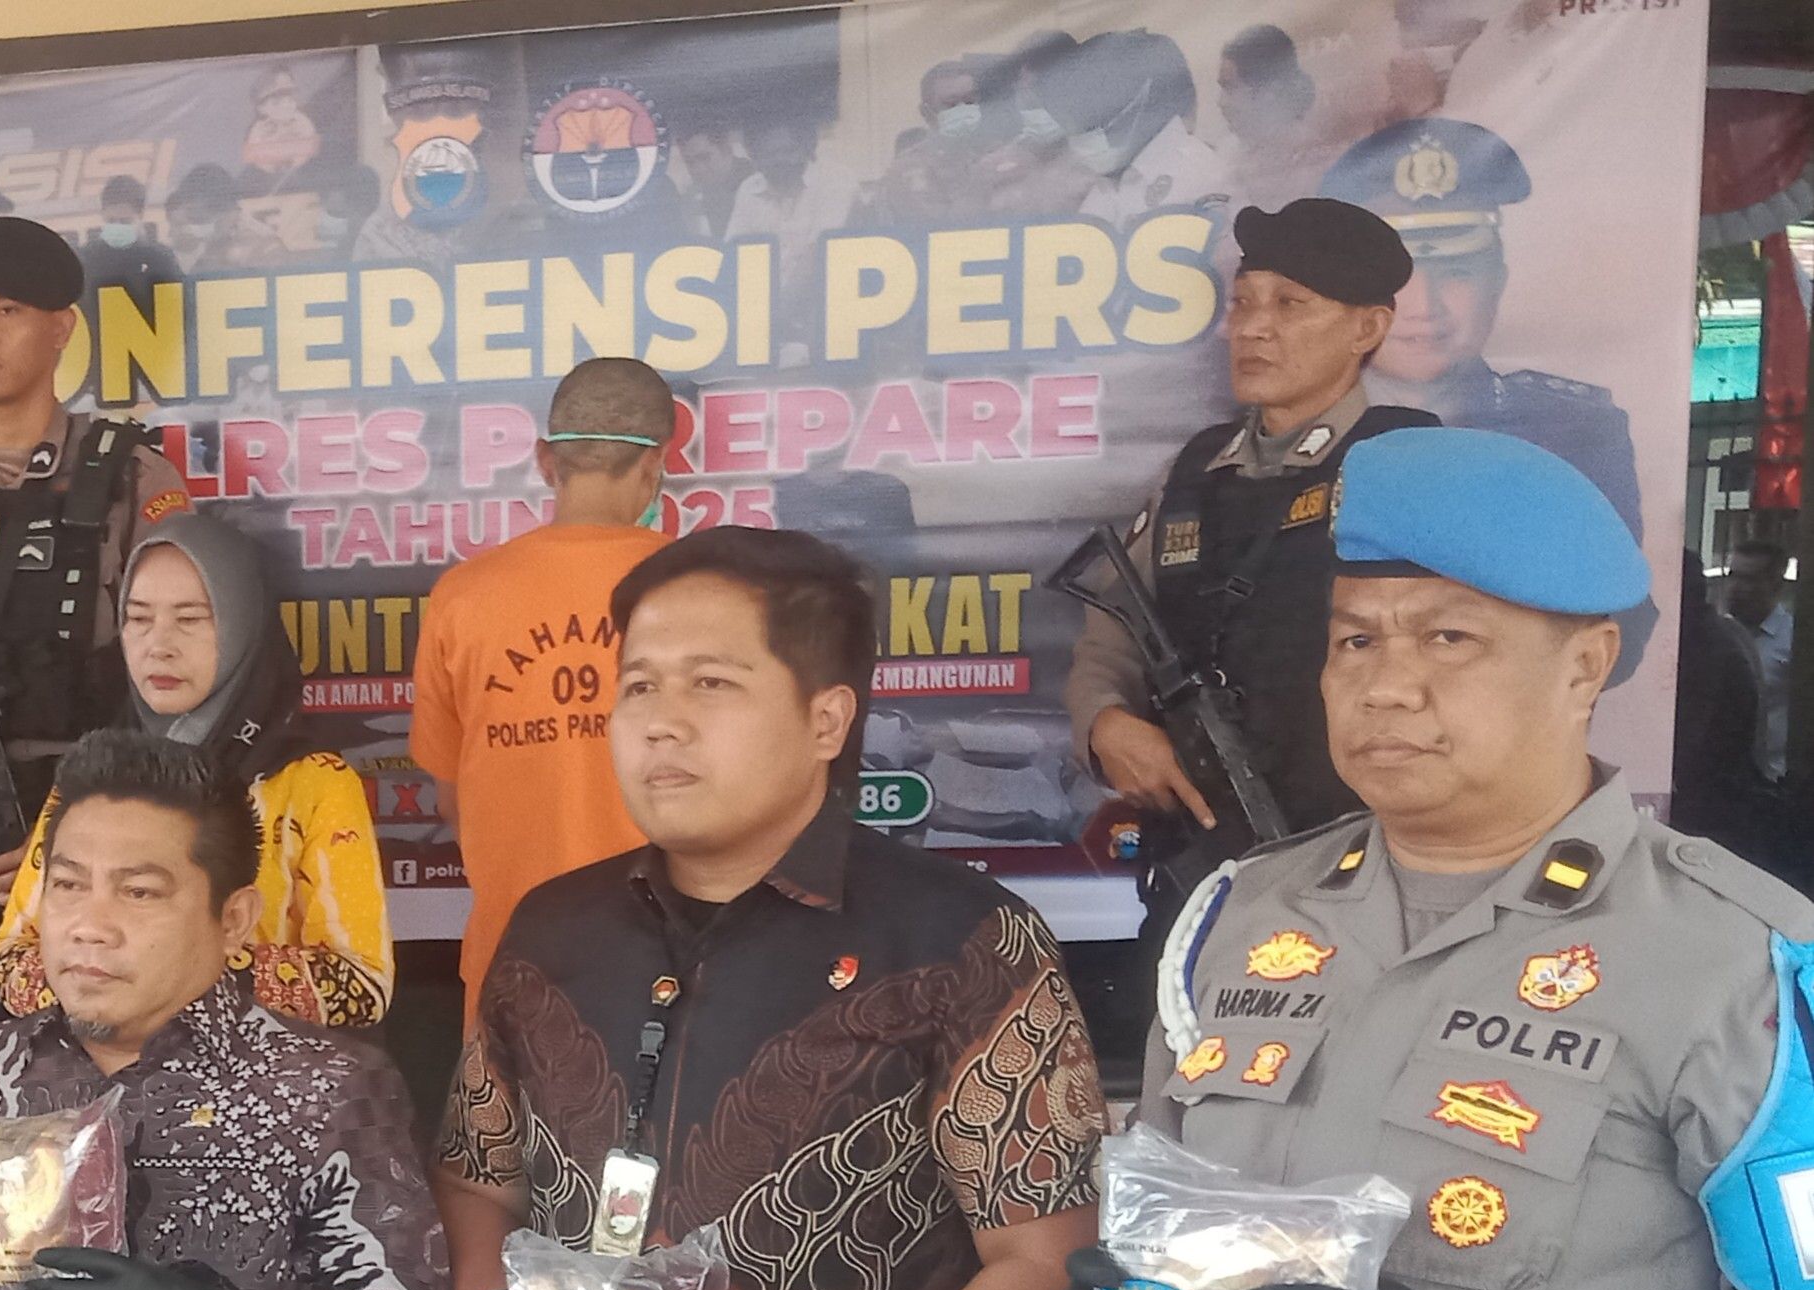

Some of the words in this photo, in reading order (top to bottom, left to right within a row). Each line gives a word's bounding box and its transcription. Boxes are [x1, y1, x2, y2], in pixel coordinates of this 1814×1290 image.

[824, 213, 1219, 362] PERS
[162, 409, 427, 498] LRES
[462, 376, 1100, 487] PEPARE
[280, 596, 429, 676] UNT
[485, 613, 619, 695] TAHAN
[302, 683, 327, 706] SA
[393, 681, 416, 704] PO
[871, 663, 1016, 691] EMBANGUNAN
[552, 663, 600, 705] 09
[488, 717, 558, 748] POLRES
[567, 712, 610, 739] PAR
[425, 862, 466, 881] polr
[1290, 993, 1326, 1018] ZA
[1441, 1009, 1603, 1071] POLRI
